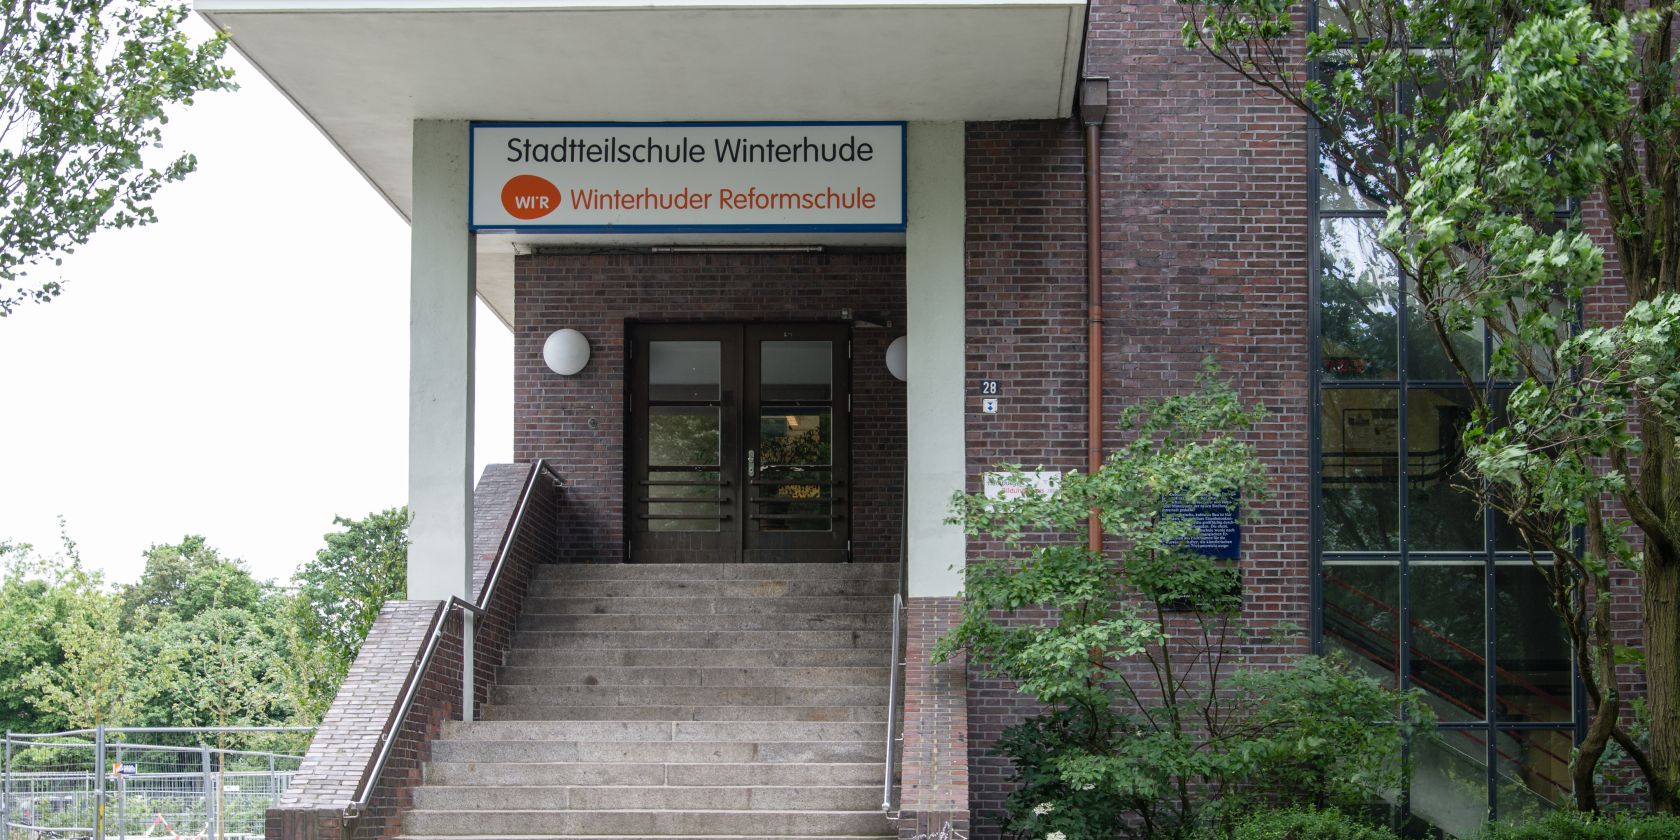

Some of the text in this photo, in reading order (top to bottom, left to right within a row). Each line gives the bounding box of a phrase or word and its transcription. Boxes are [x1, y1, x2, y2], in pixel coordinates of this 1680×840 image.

[507, 135, 874, 163] Stadtteilschule Winterhude
[570, 186, 876, 210] Winterhuder Reformschule
[982, 381, 997, 394] 28
